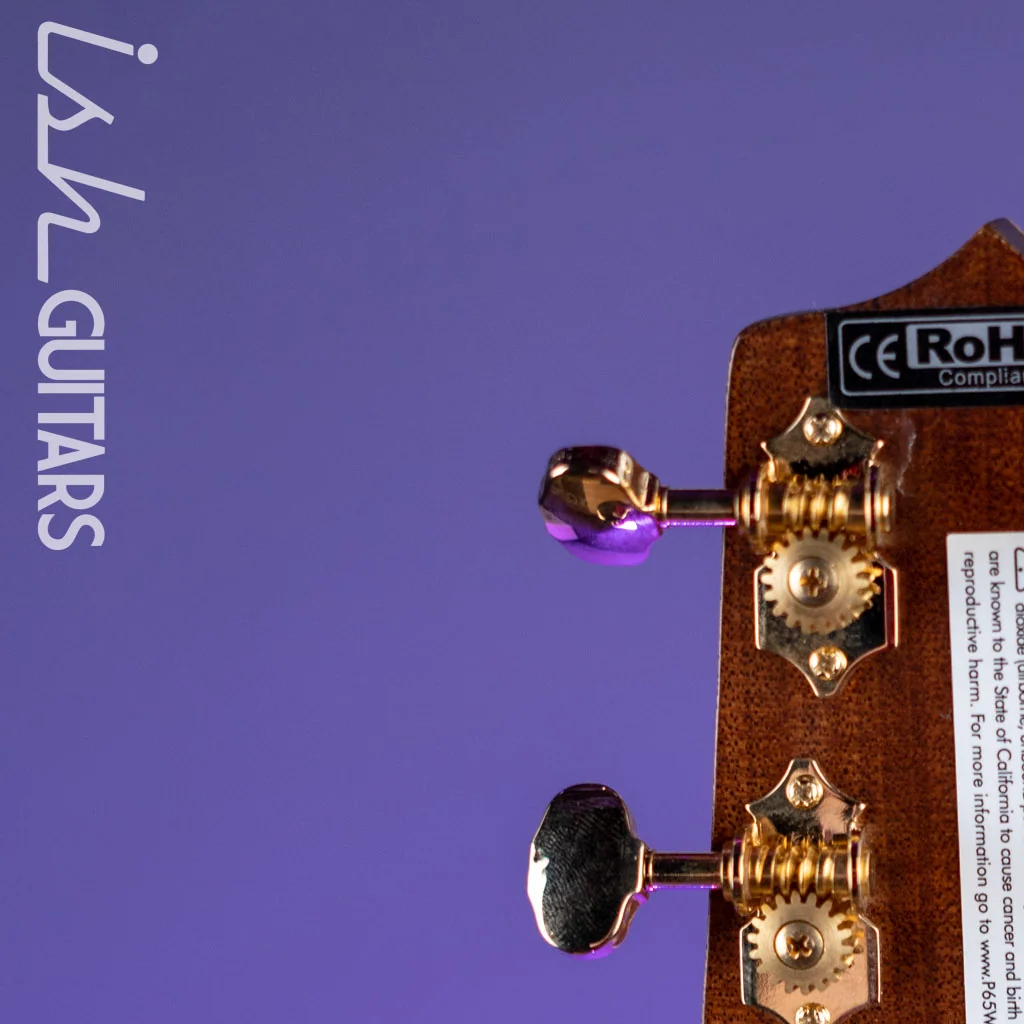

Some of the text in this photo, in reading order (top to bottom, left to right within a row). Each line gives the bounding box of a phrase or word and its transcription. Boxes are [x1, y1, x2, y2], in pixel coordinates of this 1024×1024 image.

[988, 550, 1000, 576] are
[961, 552, 980, 653] reproductive
[990, 582, 1005, 632] known
[992, 638, 1004, 652] to
[968, 660, 982, 707] harm.
[994, 657, 1008, 680] the
[994, 686, 1009, 723] State
[970, 714, 985, 739] For
[996, 728, 1012, 743] of
[972, 746, 983, 787] more
[996, 748, 1014, 824] California
[974, 794, 991, 887] information
[1000, 828, 1013, 844] to
[1000, 848, 1012, 892] cause
[974, 892, 988, 914] go
[979, 919, 992, 934] to
[1002, 896, 1014, 947] cancer
[1005, 952, 1021, 981] and
[1006, 986, 1022, 1020] birth
